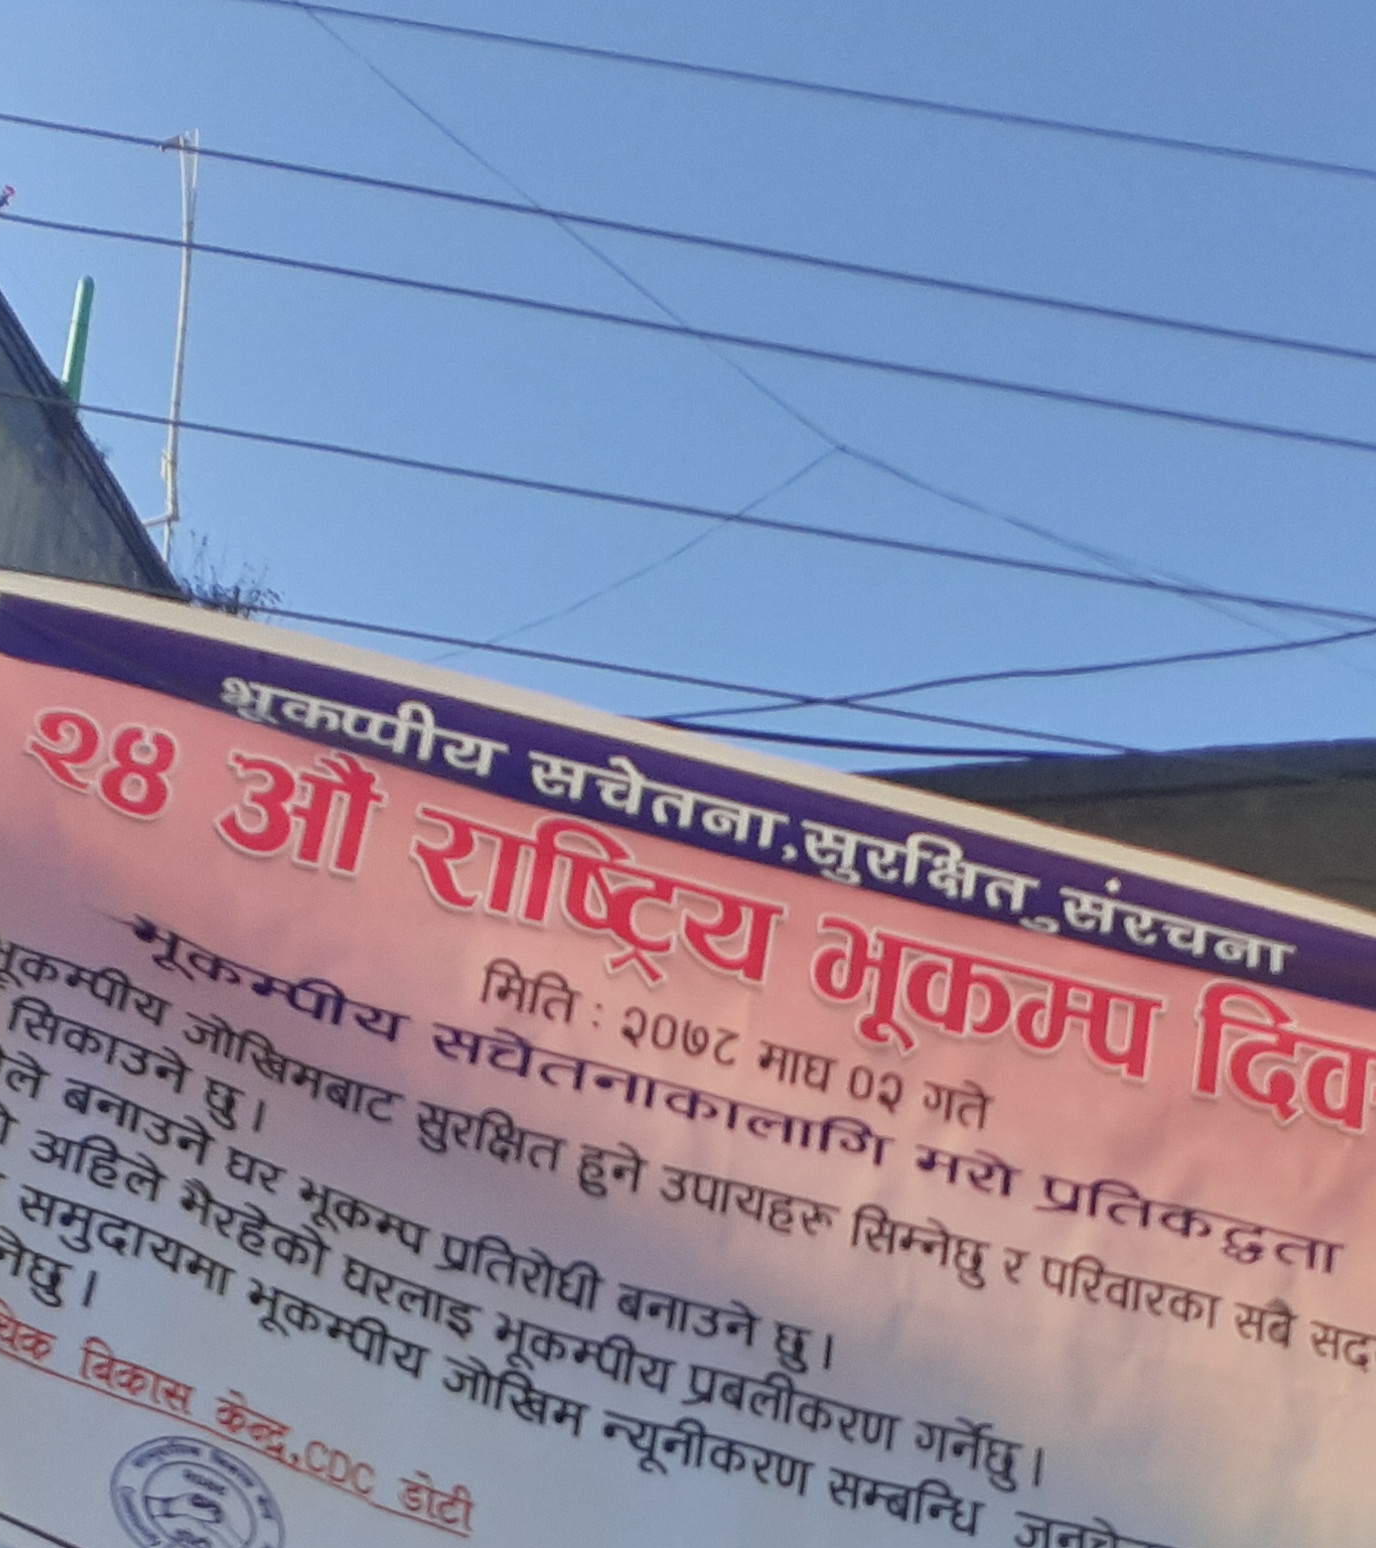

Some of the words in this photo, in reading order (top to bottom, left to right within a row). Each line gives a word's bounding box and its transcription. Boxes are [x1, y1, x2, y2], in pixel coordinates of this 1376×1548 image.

[27, 709, 176, 818] २४
[813, 914, 1164, 1080] भूकम्प
[8, 996, 192, 1095] सिकाउने
[184, 1012, 402, 1123] जोखिमबाट
[417, 1098, 567, 1171] सुरक्षित
[578, 1141, 647, 1198] हुने
[1003, 1248, 1028, 1284] र
[1042, 1253, 1221, 1329] परिवारका
[620, 1005, 741, 1066] २०७८
[757, 1039, 839, 1094] माघ
[846, 1064, 904, 1113] ०२
[924, 1080, 995, 1129] गते
[19, 1183, 236, 1297] समुदायमा
[248, 1277, 430, 1380] भूकम्पीय
[441, 1356, 590, 1439] जोखिम
[603, 1409, 814, 1496] न्यूनीकरण
[30, 1129, 168, 1201] अहिले
[495, 1310, 675, 1393] भूकम्पीय
[64, 1077, 215, 1167] बनाउने
[227, 1146, 287, 1194] घर
[298, 1175, 429, 1255] भूकम्प
[437, 1230, 604, 1311] प्रतिरोधी
[616, 1282, 761, 1348] बनाउने
[80, 1336, 196, 1415] विकास
[399, 1470, 475, 1532] डोटी
